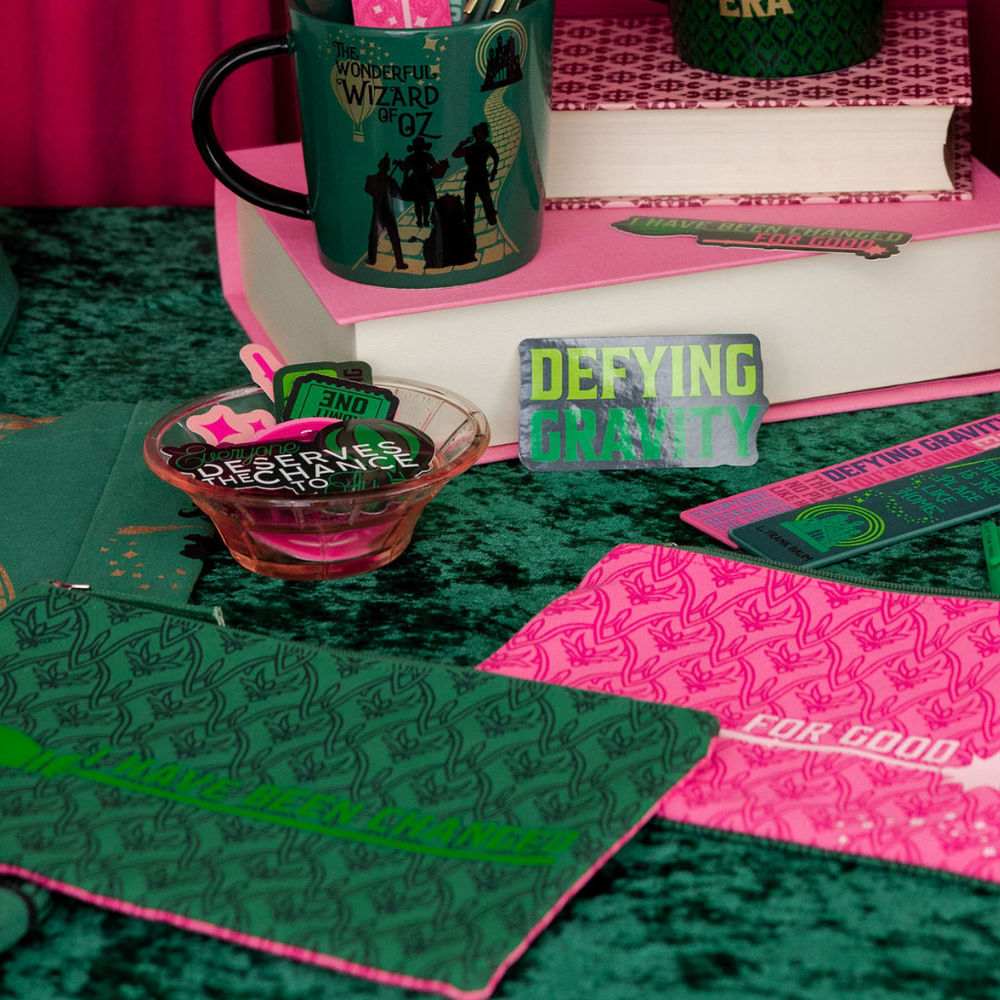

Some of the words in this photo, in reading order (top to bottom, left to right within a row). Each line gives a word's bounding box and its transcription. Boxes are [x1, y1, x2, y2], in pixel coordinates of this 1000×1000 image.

[332, 41, 360, 60] THE
[335, 60, 437, 82] WONDERFUL
[337, 79, 440, 109] WIZARD
[378, 108, 399, 123] OF
[399, 111, 443, 139] OZ
[640, 218, 709, 231] HAVE
[715, 222, 785, 234] BEEN
[788, 226, 905, 242] CHANGED
[752, 233, 804, 245] FOR
[807, 236, 876, 249] GOOD
[530, 343, 756, 400] DEFYING
[318, 390, 368, 415] ONE
[530, 405, 762, 462] GRAVITY
[174, 442, 301, 470] Everyone
[821, 444, 923, 482] DEFYING
[911, 439, 979, 471] GONNA
[922, 484, 957, 504] LIKE
[932, 474, 984, 503] PLACE
[690, 490, 771, 519] EVERYONE
[702, 497, 784, 526] DESERVES
[763, 529, 789, 547] FRANK
[742, 714, 832, 743] FOR
[839, 725, 960, 764] GOOD
[113, 754, 242, 798] HAVE
[243, 784, 363, 824] BEEN
[367, 806, 579, 853] CHANGED
